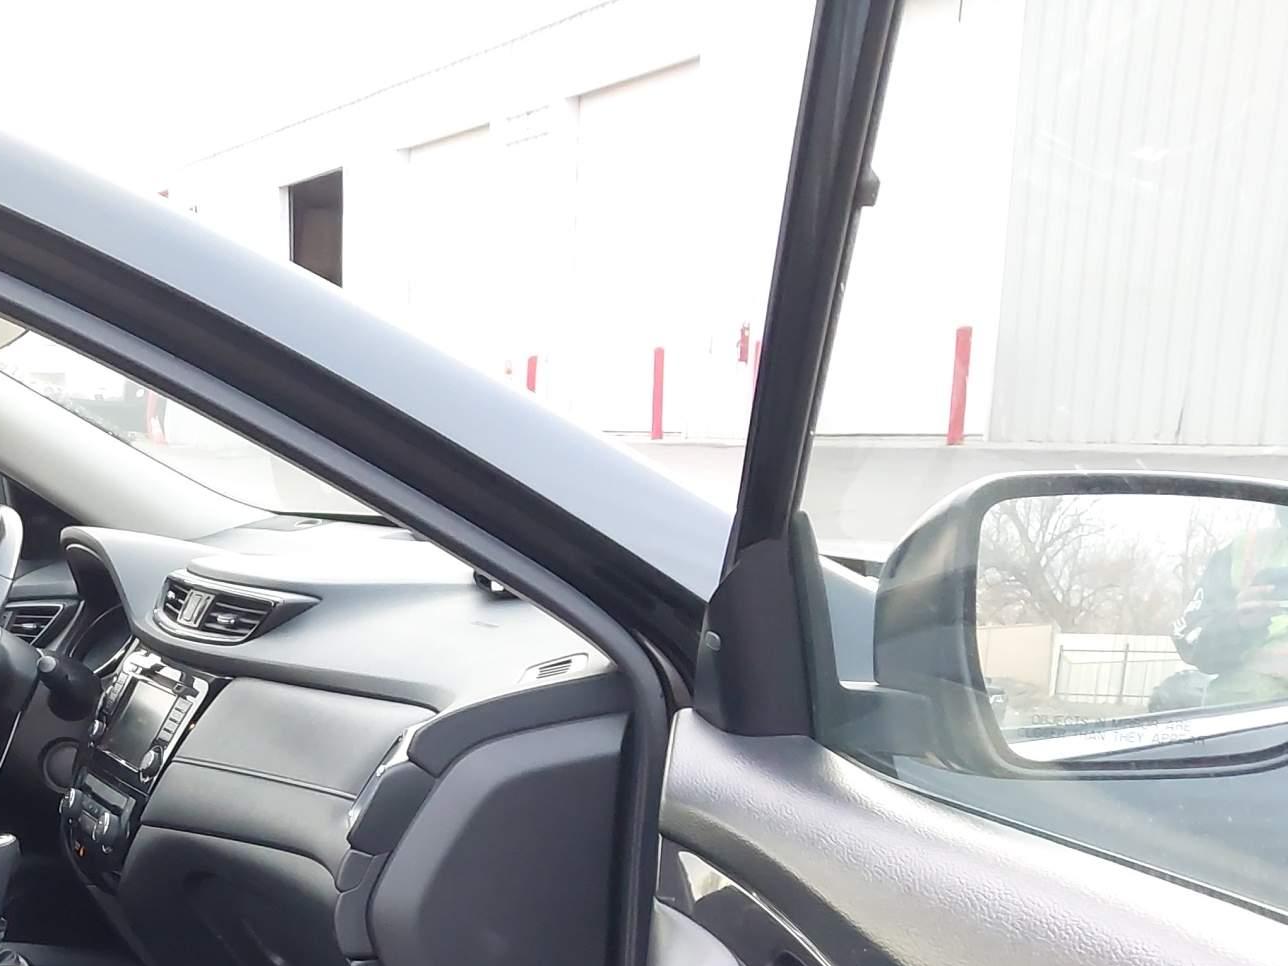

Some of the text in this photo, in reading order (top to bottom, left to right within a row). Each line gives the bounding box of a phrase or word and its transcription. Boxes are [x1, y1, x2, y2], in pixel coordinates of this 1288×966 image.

[1031, 713, 1089, 727] OBJECTS
[1166, 719, 1192, 732] ARE
[1113, 730, 1144, 743] THEY
